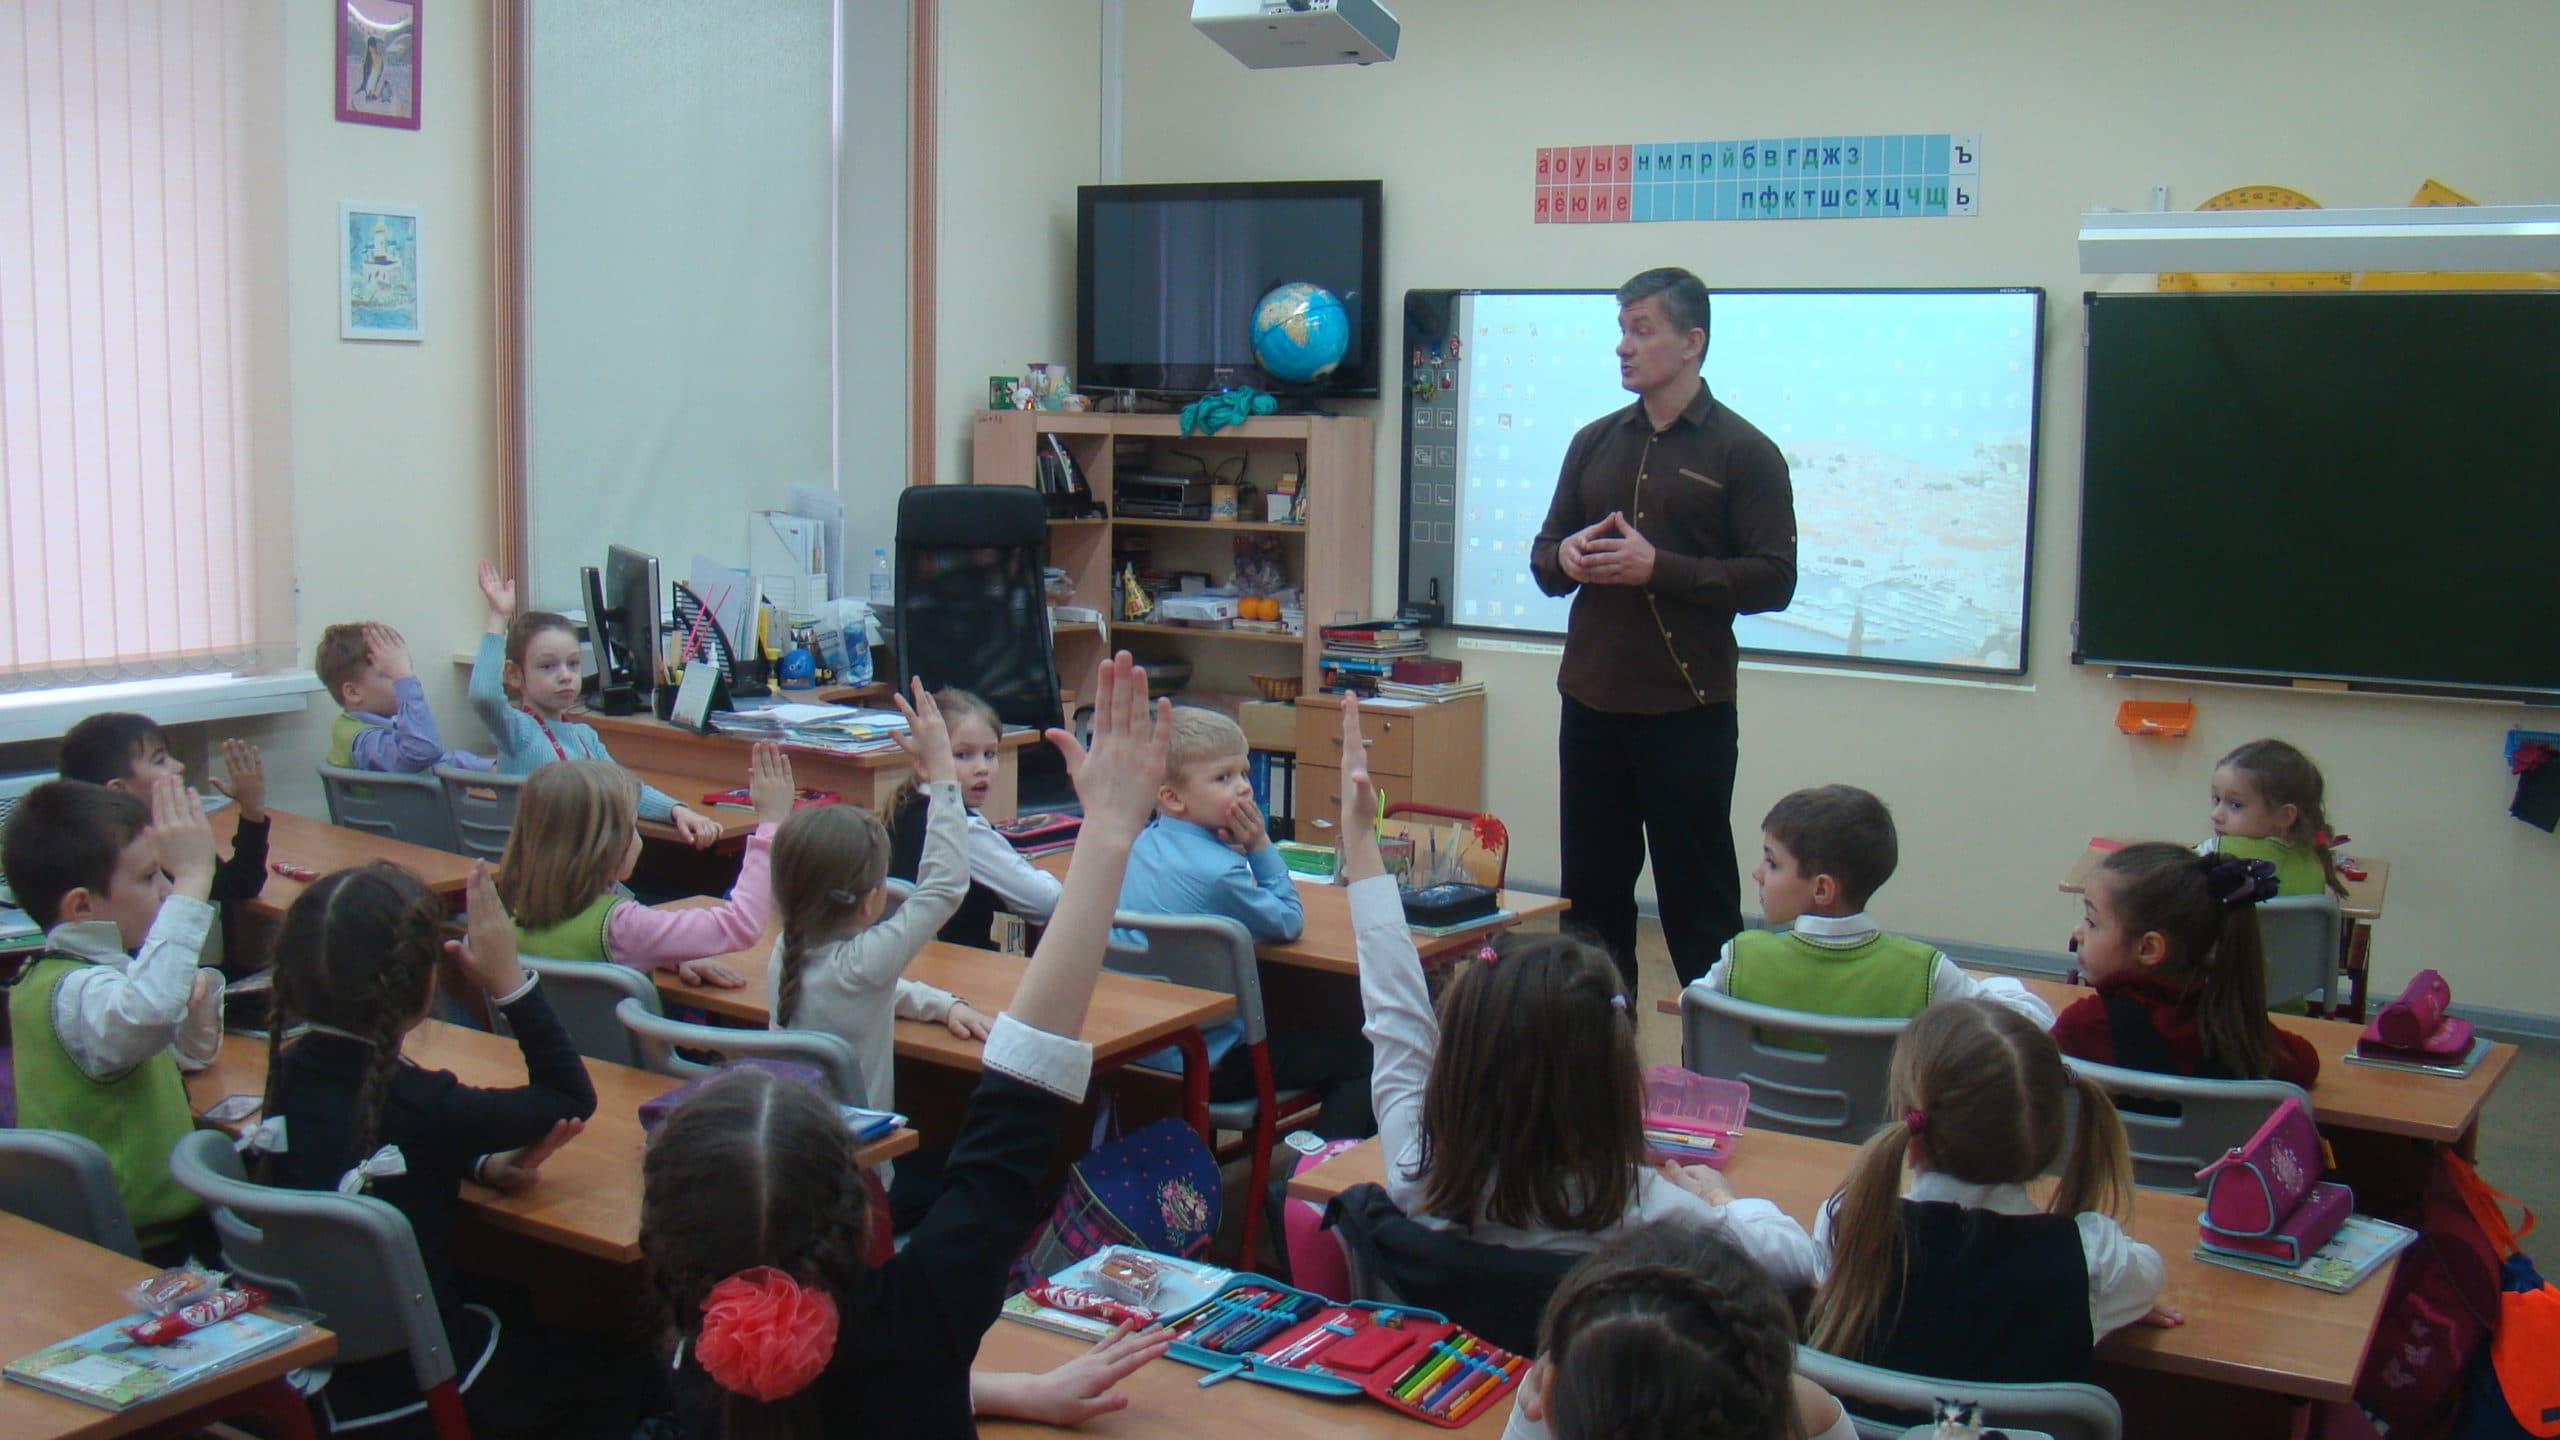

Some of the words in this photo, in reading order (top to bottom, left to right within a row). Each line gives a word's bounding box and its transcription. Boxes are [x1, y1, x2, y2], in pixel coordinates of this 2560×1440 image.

[1539, 157, 1548, 173] а
[1556, 158, 1566, 172] о
[1575, 156, 1586, 178] у
[1596, 157, 1611, 172] ы
[1619, 157, 1629, 172] э
[1639, 156, 1648, 170] н
[1658, 156, 1672, 170] м
[1679, 155, 1692, 169] л
[1701, 153, 1712, 173] р
[1723, 148, 1734, 168] й
[1743, 146, 1756, 169] б
[1765, 150, 1777, 165] в
[1788, 149, 1797, 165] г
[1802, 148, 1818, 169] д
[1848, 147, 1859, 164] з
[1537, 198, 1547, 212] я
[1555, 192, 1565, 210] ё
[1572, 196, 1587, 212] ю
[1596, 195, 1606, 211] и
[1617, 194, 1628, 210] е
[1742, 192, 1753, 208] п
[1760, 186, 1778, 214] ф
[1785, 191, 1795, 208] к
[1804, 191, 1816, 207] т
[1821, 189, 1839, 207] ш
[1845, 189, 1858, 207] с
[1866, 189, 1878, 206] х
[1885, 189, 1899, 210] ц
[1907, 187, 1920, 205] ч
[1927, 186, 1946, 208] щ
